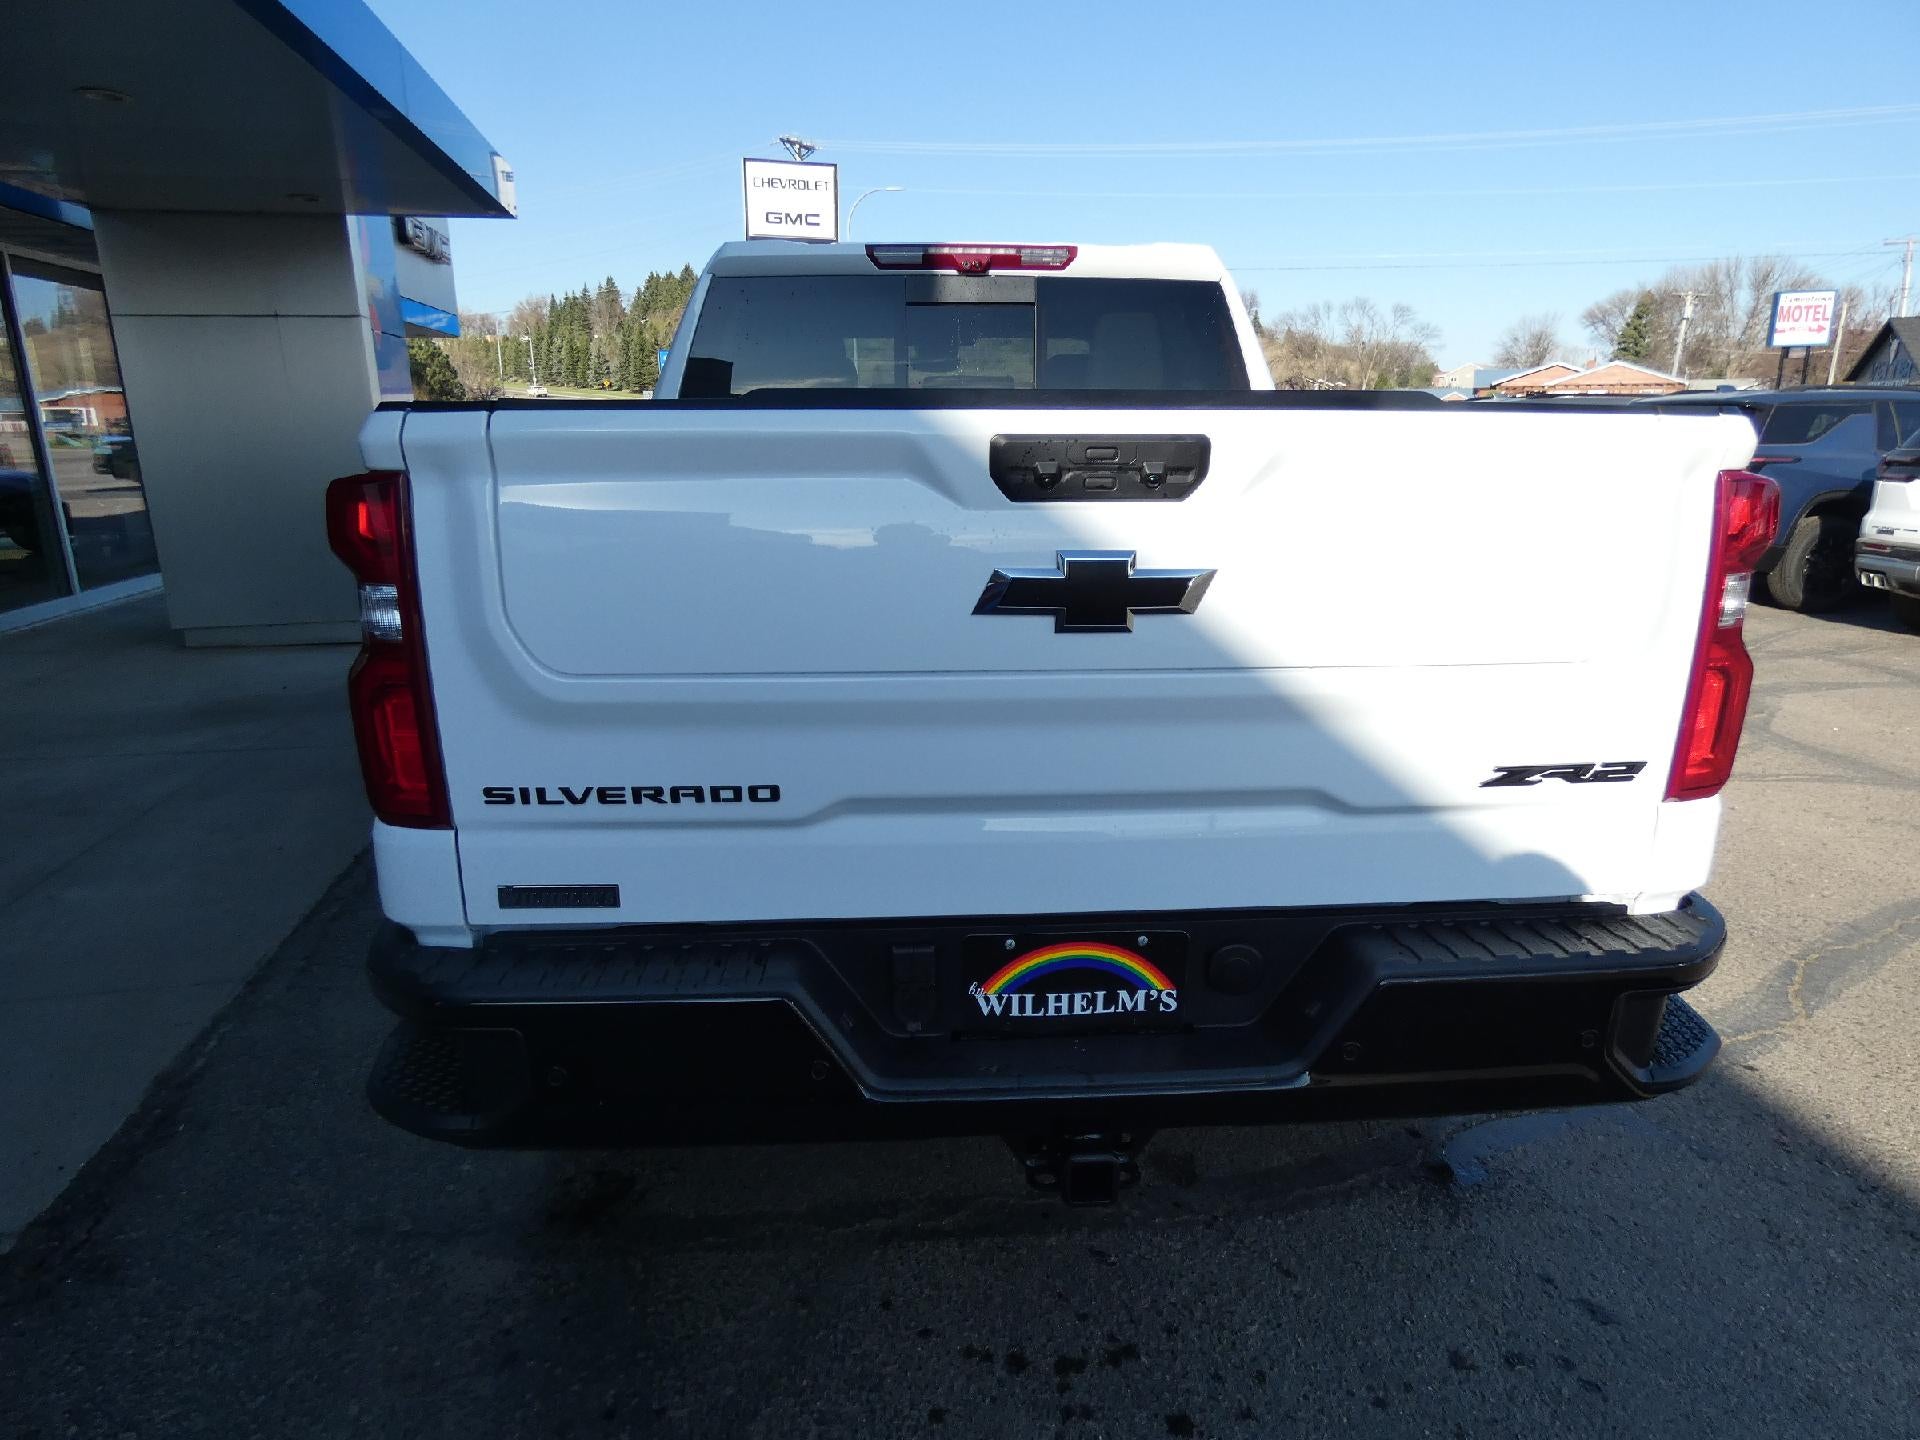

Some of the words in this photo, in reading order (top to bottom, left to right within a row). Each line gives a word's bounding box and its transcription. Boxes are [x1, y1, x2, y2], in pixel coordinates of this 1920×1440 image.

[753, 176, 831, 192] CHEVROLET
[765, 211, 821, 227] GMC
[1777, 304, 1830, 323] MOTEL
[1478, 761, 1648, 787] ZR2
[482, 784, 781, 805] SILVERADO
[976, 989, 1178, 1017] WILHELM'S
